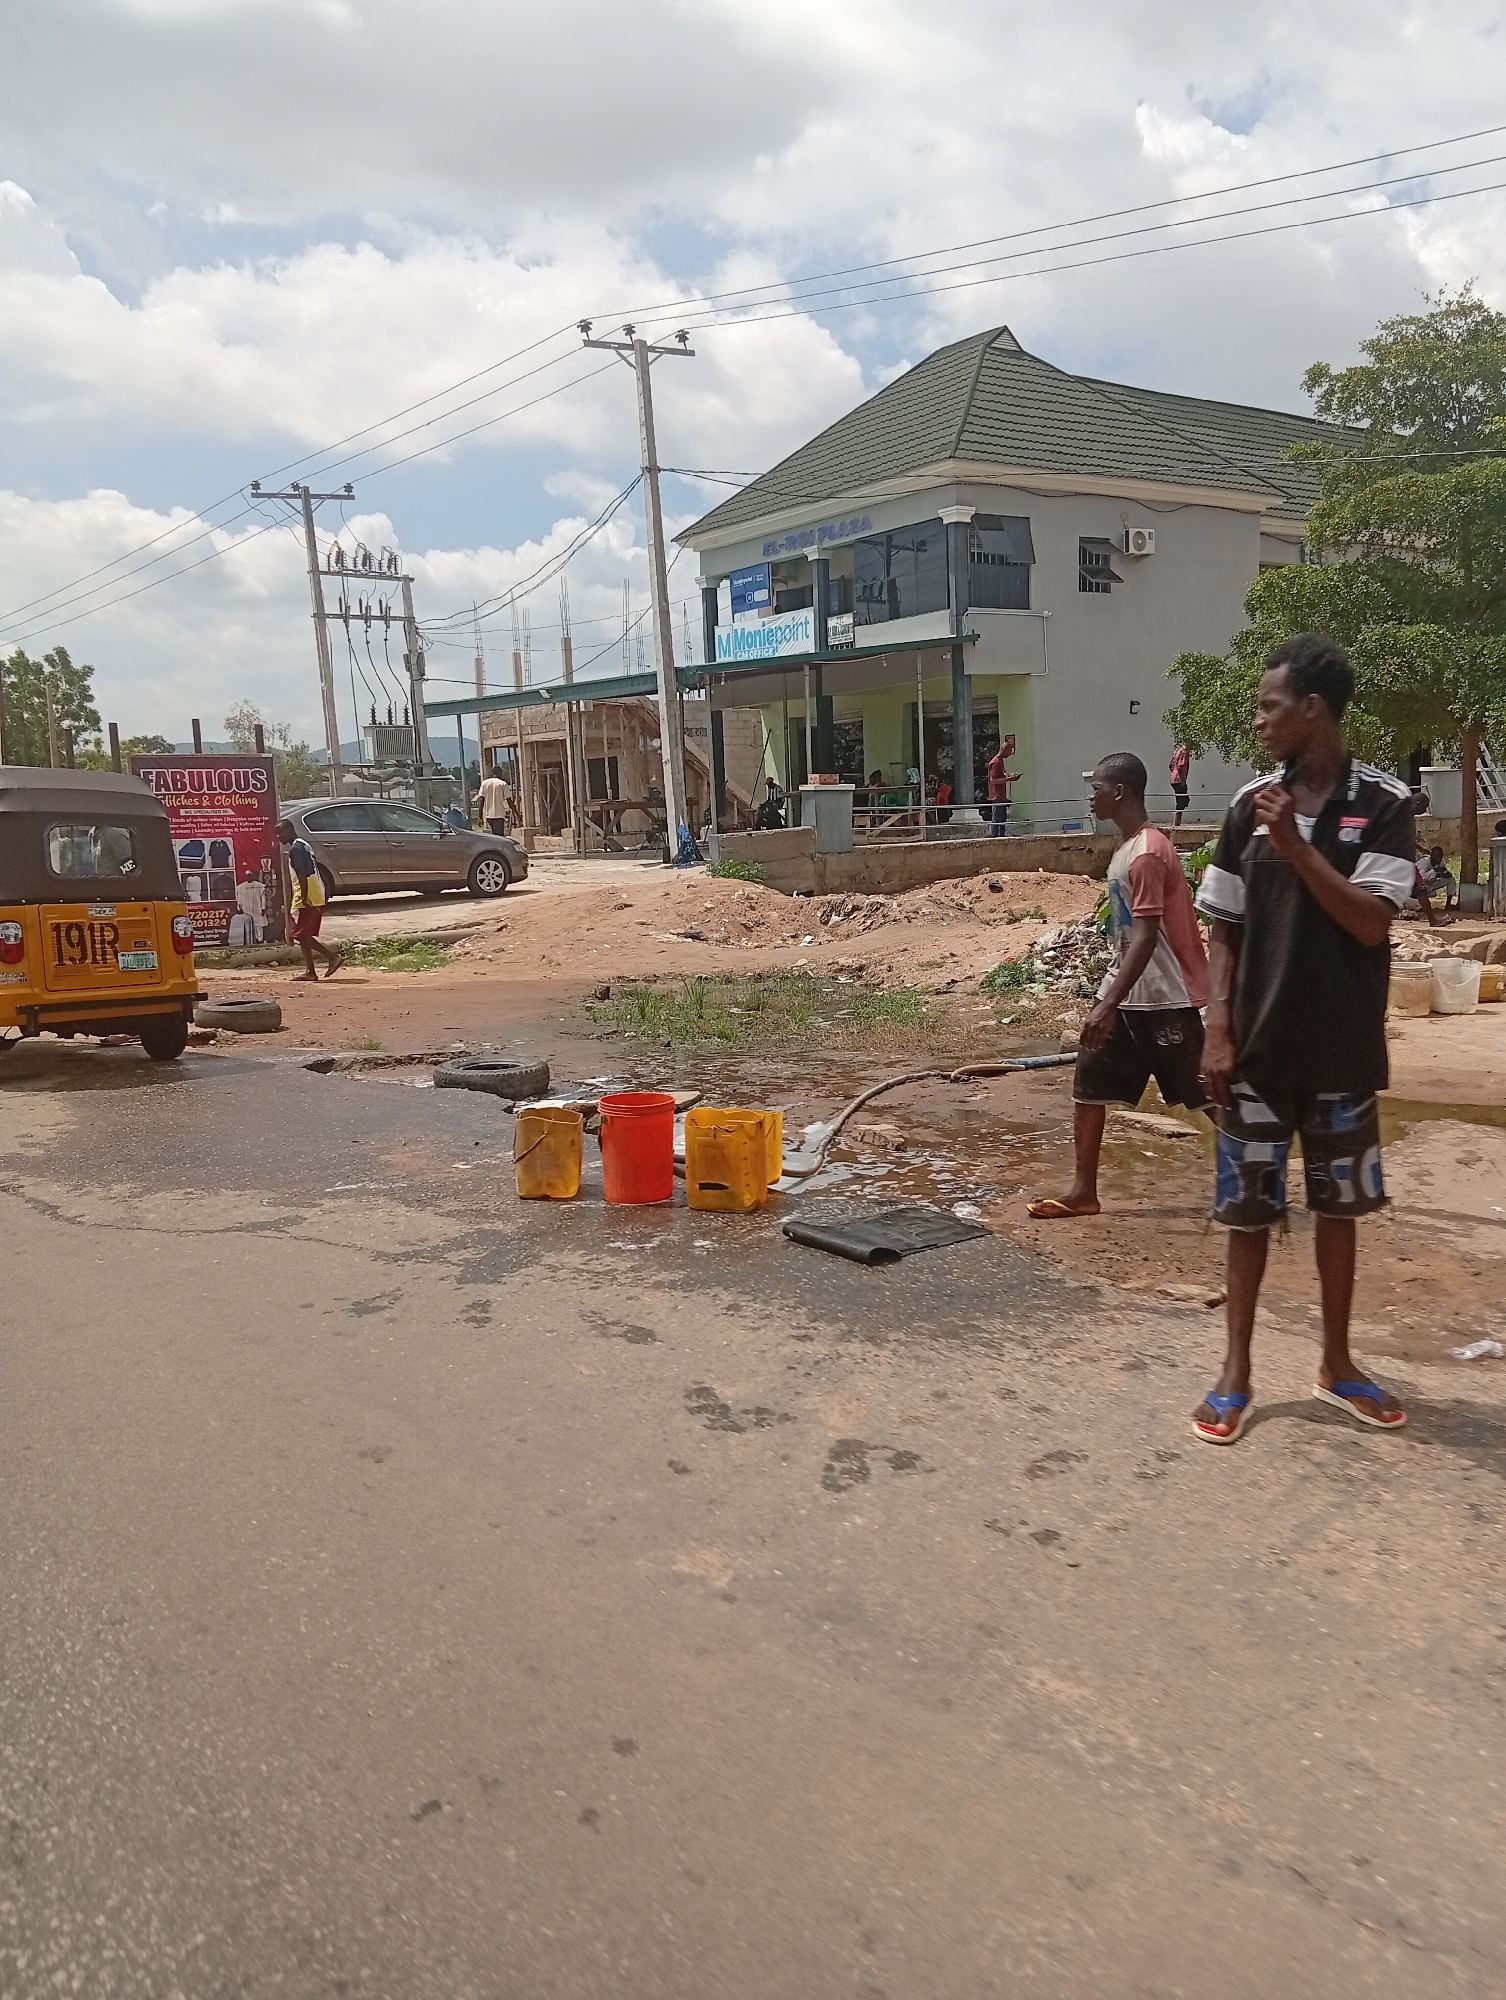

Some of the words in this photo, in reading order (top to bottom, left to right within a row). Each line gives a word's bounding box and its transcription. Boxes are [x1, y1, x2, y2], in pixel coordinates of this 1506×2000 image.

[817, 516, 872, 542] PLAZA
[733, 616, 810, 655] Moniepoint
[749, 647, 774, 658] OFFICE
[140, 768, 268, 793] FABULOUS
[202, 795, 211, 807] &
[214, 794, 258, 808] Clothing
